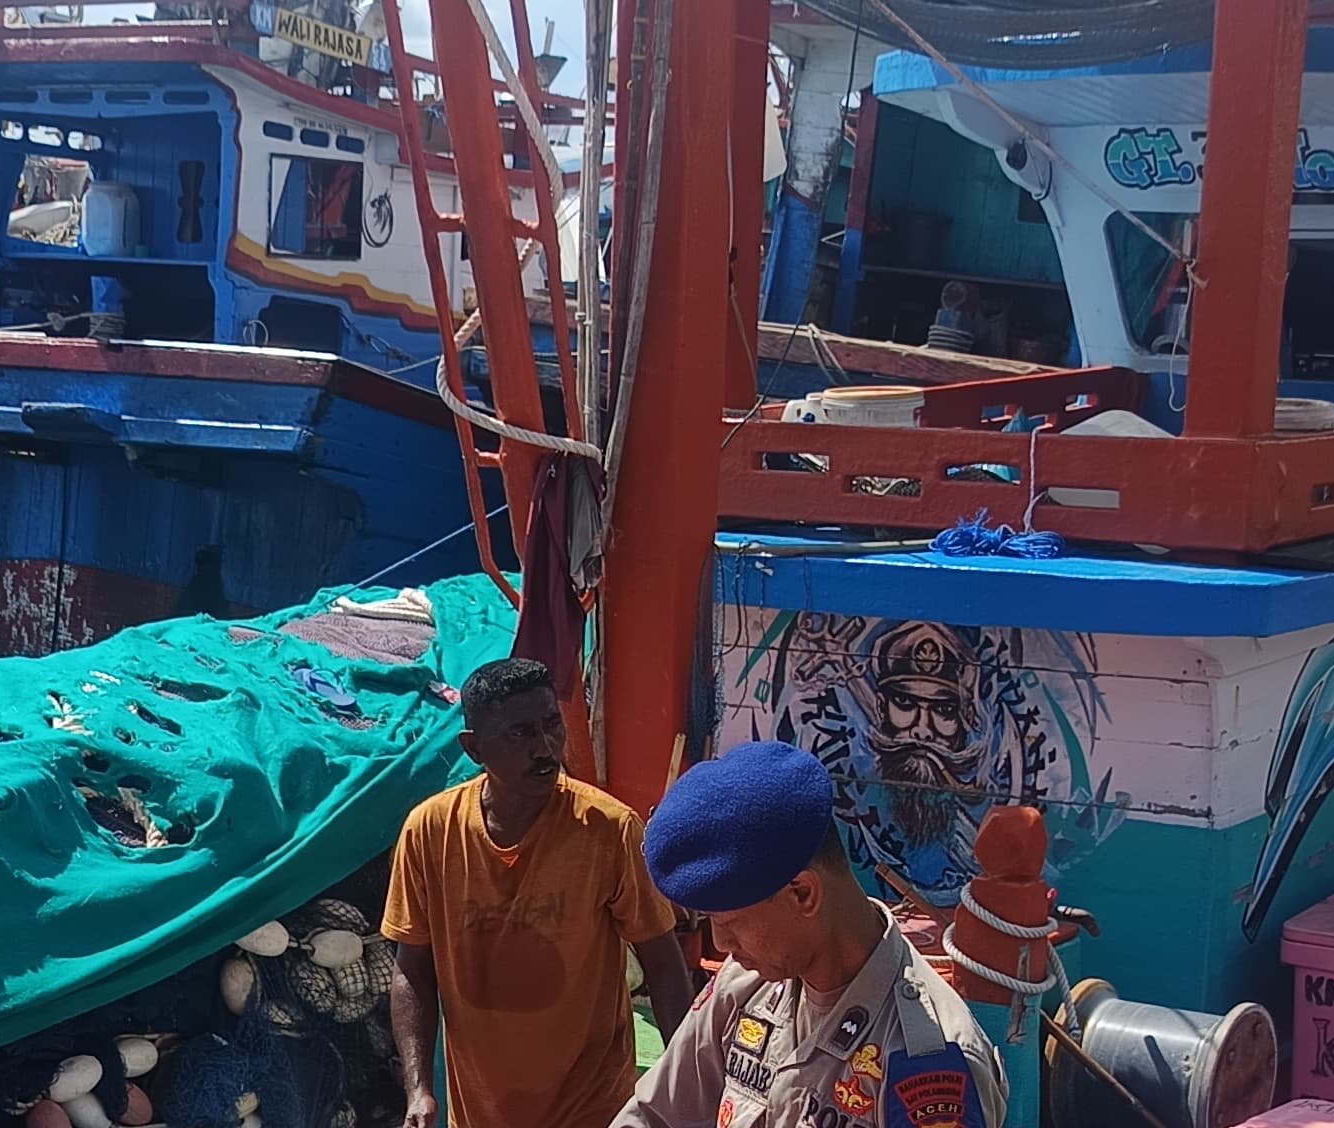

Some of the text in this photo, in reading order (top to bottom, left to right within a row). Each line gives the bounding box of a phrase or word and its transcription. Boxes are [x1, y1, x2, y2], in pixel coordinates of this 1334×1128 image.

[278, 12, 311, 41] WALI
[313, 26, 363, 60] RAJASA
[916, 1103, 959, 1120] ACEH
